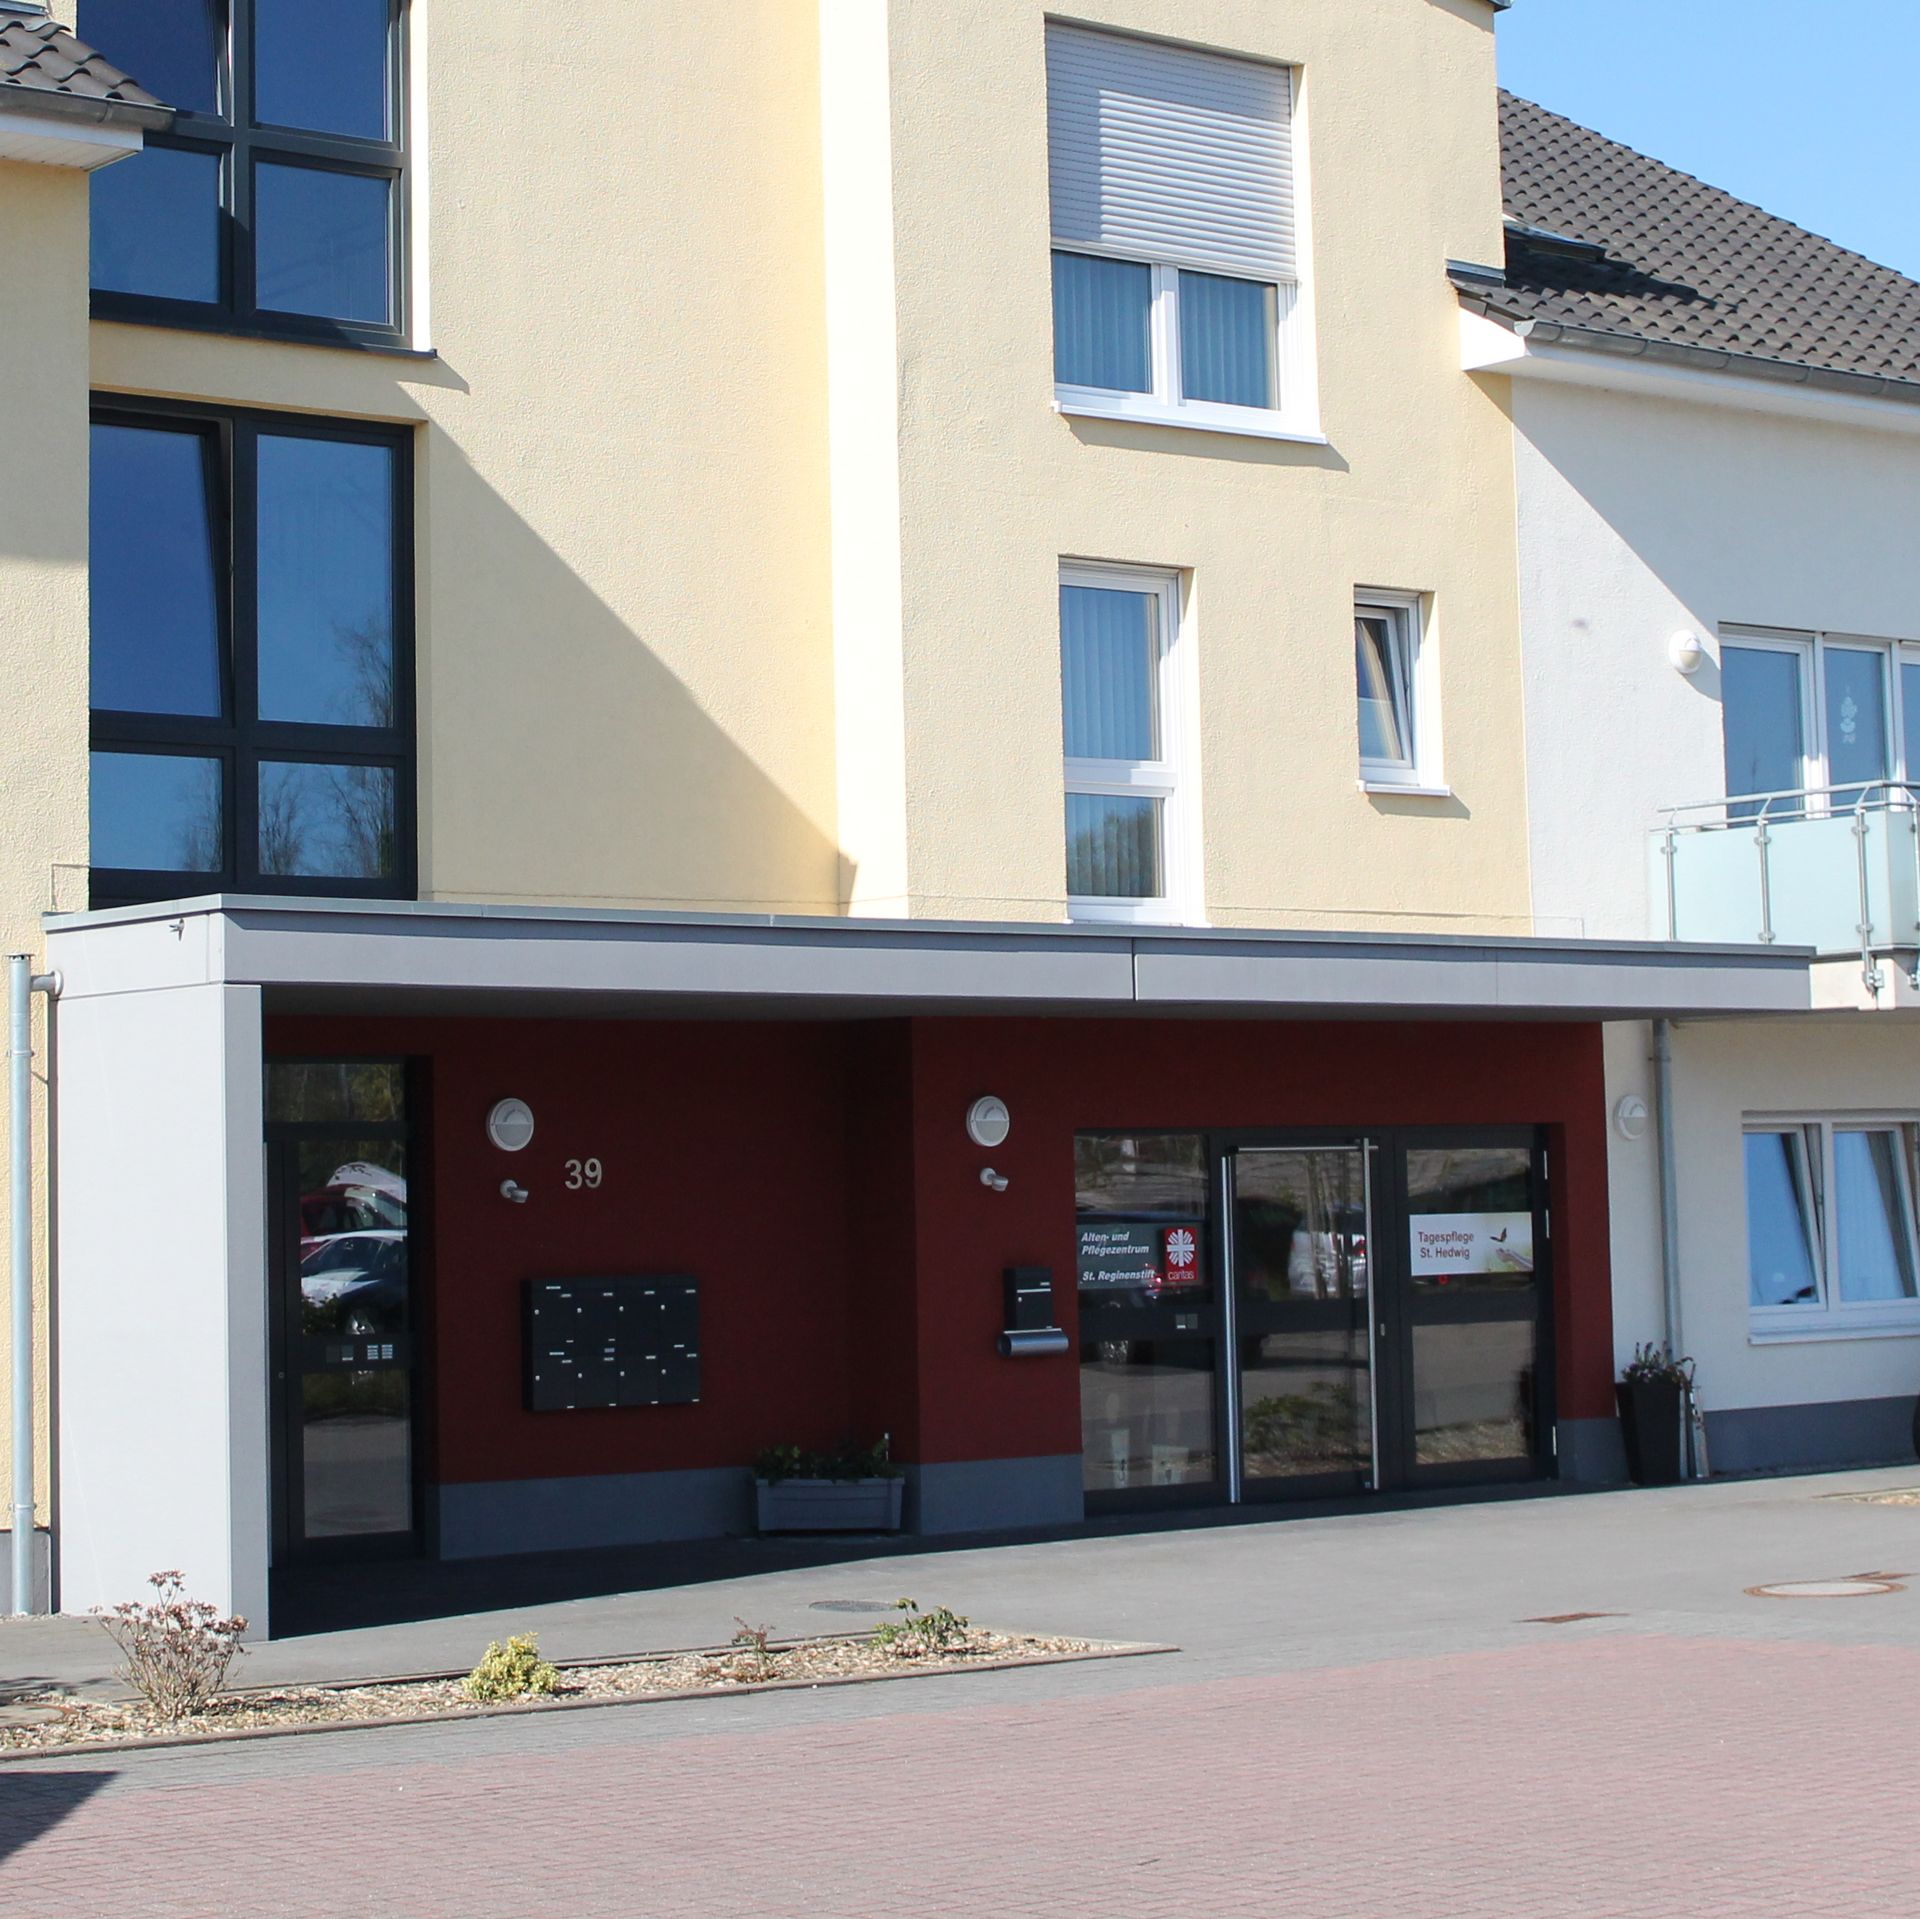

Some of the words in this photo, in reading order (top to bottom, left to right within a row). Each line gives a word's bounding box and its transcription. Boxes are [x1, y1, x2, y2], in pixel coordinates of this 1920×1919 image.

[564, 1158, 602, 1189] 39
[1081, 1232, 1110, 1242] Alten-
[1111, 1231, 1130, 1241] und
[1418, 1231, 1474, 1244] Tagespflege
[1081, 1245, 1149, 1257] Pflegezentrum
[1420, 1247, 1433, 1258] St.
[1435, 1247, 1470, 1259] Hedwig
[1082, 1271, 1096, 1281] St.
[1098, 1270, 1155, 1282] Reginenstift
